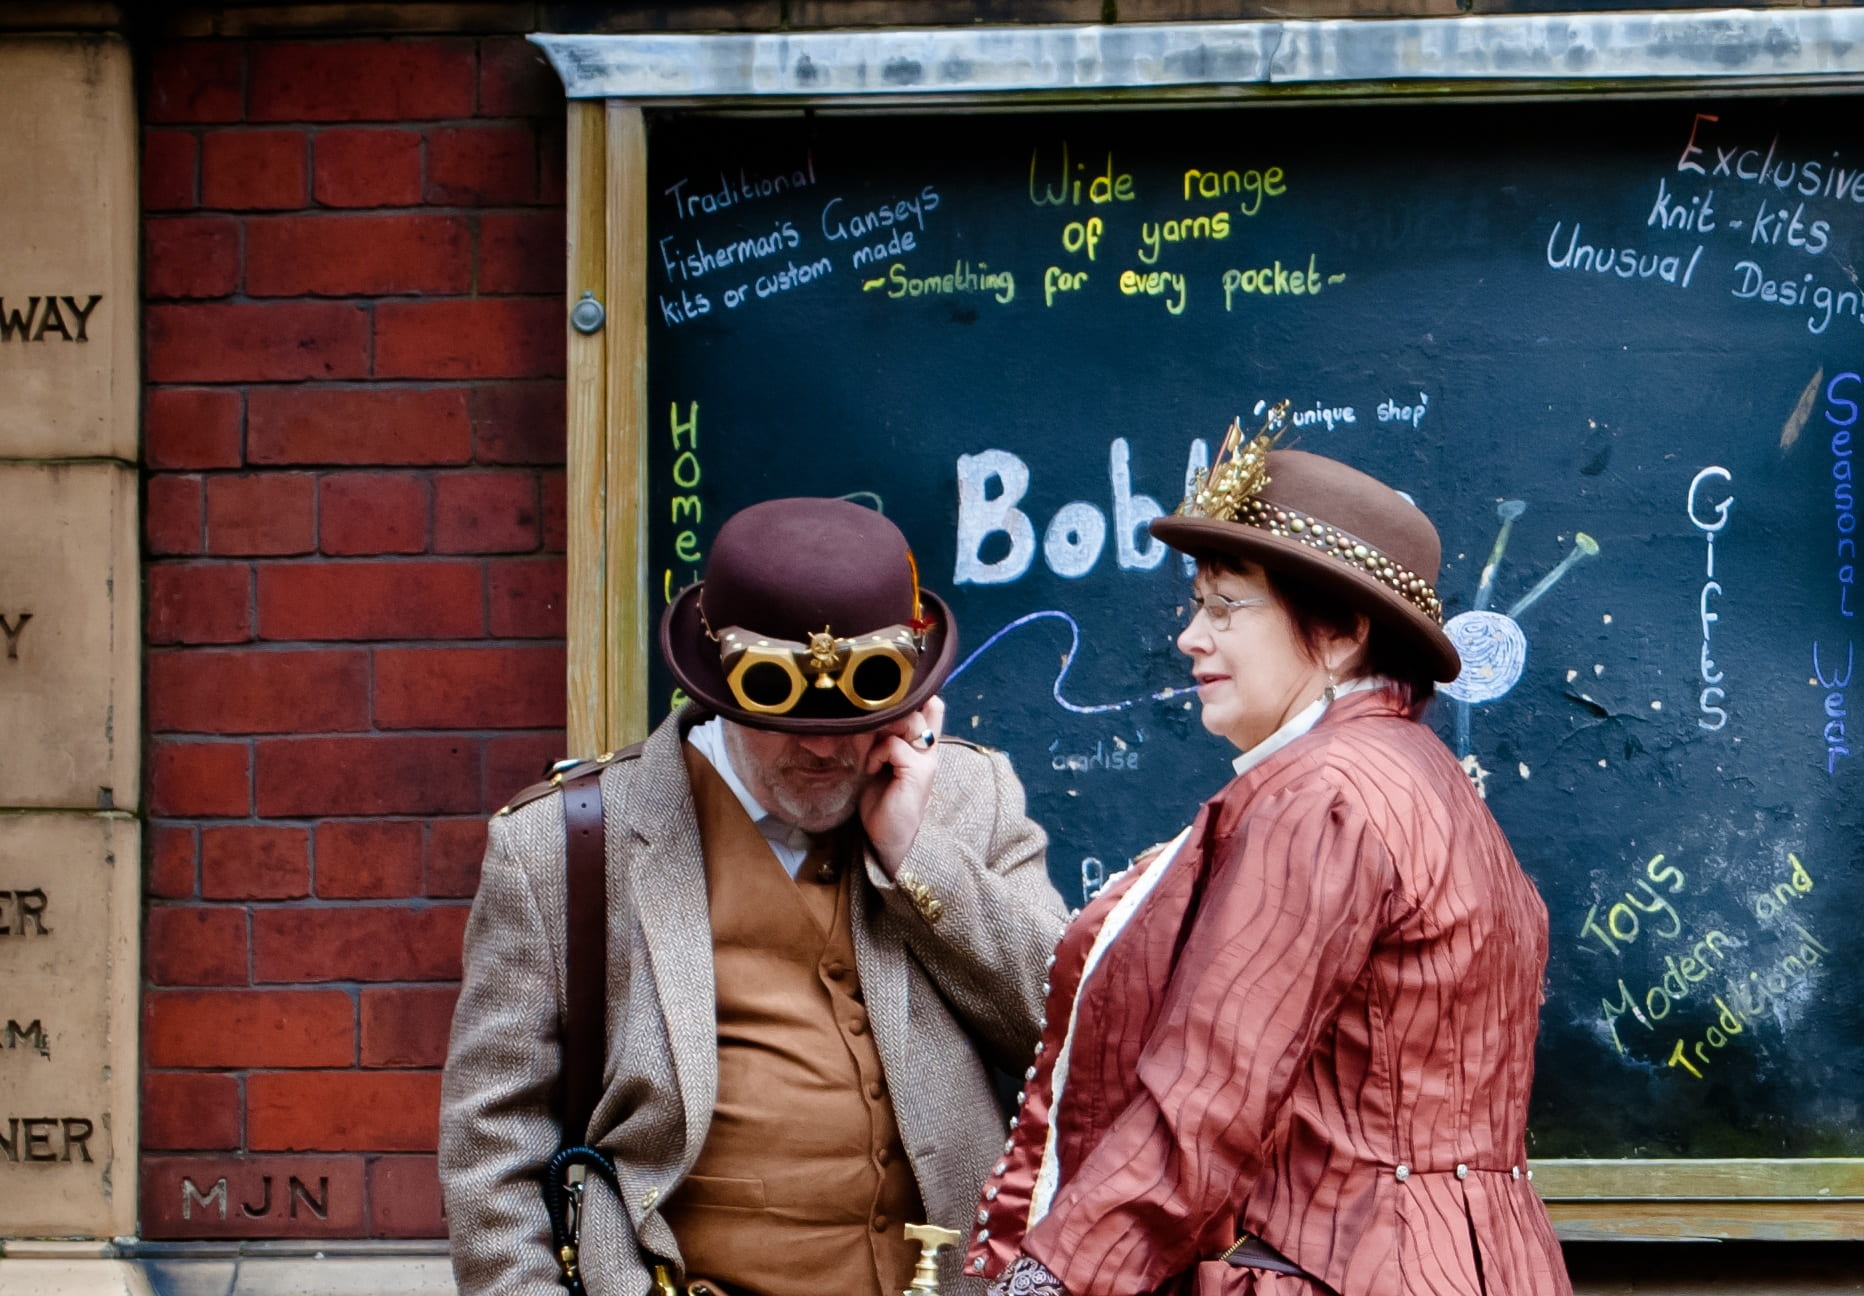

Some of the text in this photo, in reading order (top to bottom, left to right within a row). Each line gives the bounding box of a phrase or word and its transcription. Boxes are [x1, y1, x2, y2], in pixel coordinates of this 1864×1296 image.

[664, 147, 817, 219] Traditional
[821, 185, 940, 241] Ganseys
[1029, 138, 1287, 216] Wide range
[1062, 211, 1230, 265] of yarns
[1546, 221, 1704, 288] Unusual
[659, 228, 916, 327] kits or custom made
[1044, 266, 1088, 307] for
[1119, 269, 1186, 315] every
[1292, 400, 1357, 432] unique
[669, 400, 702, 562] Home
[1687, 464, 1734, 731] Gifts
[1602, 852, 1814, 1054] Modern and
